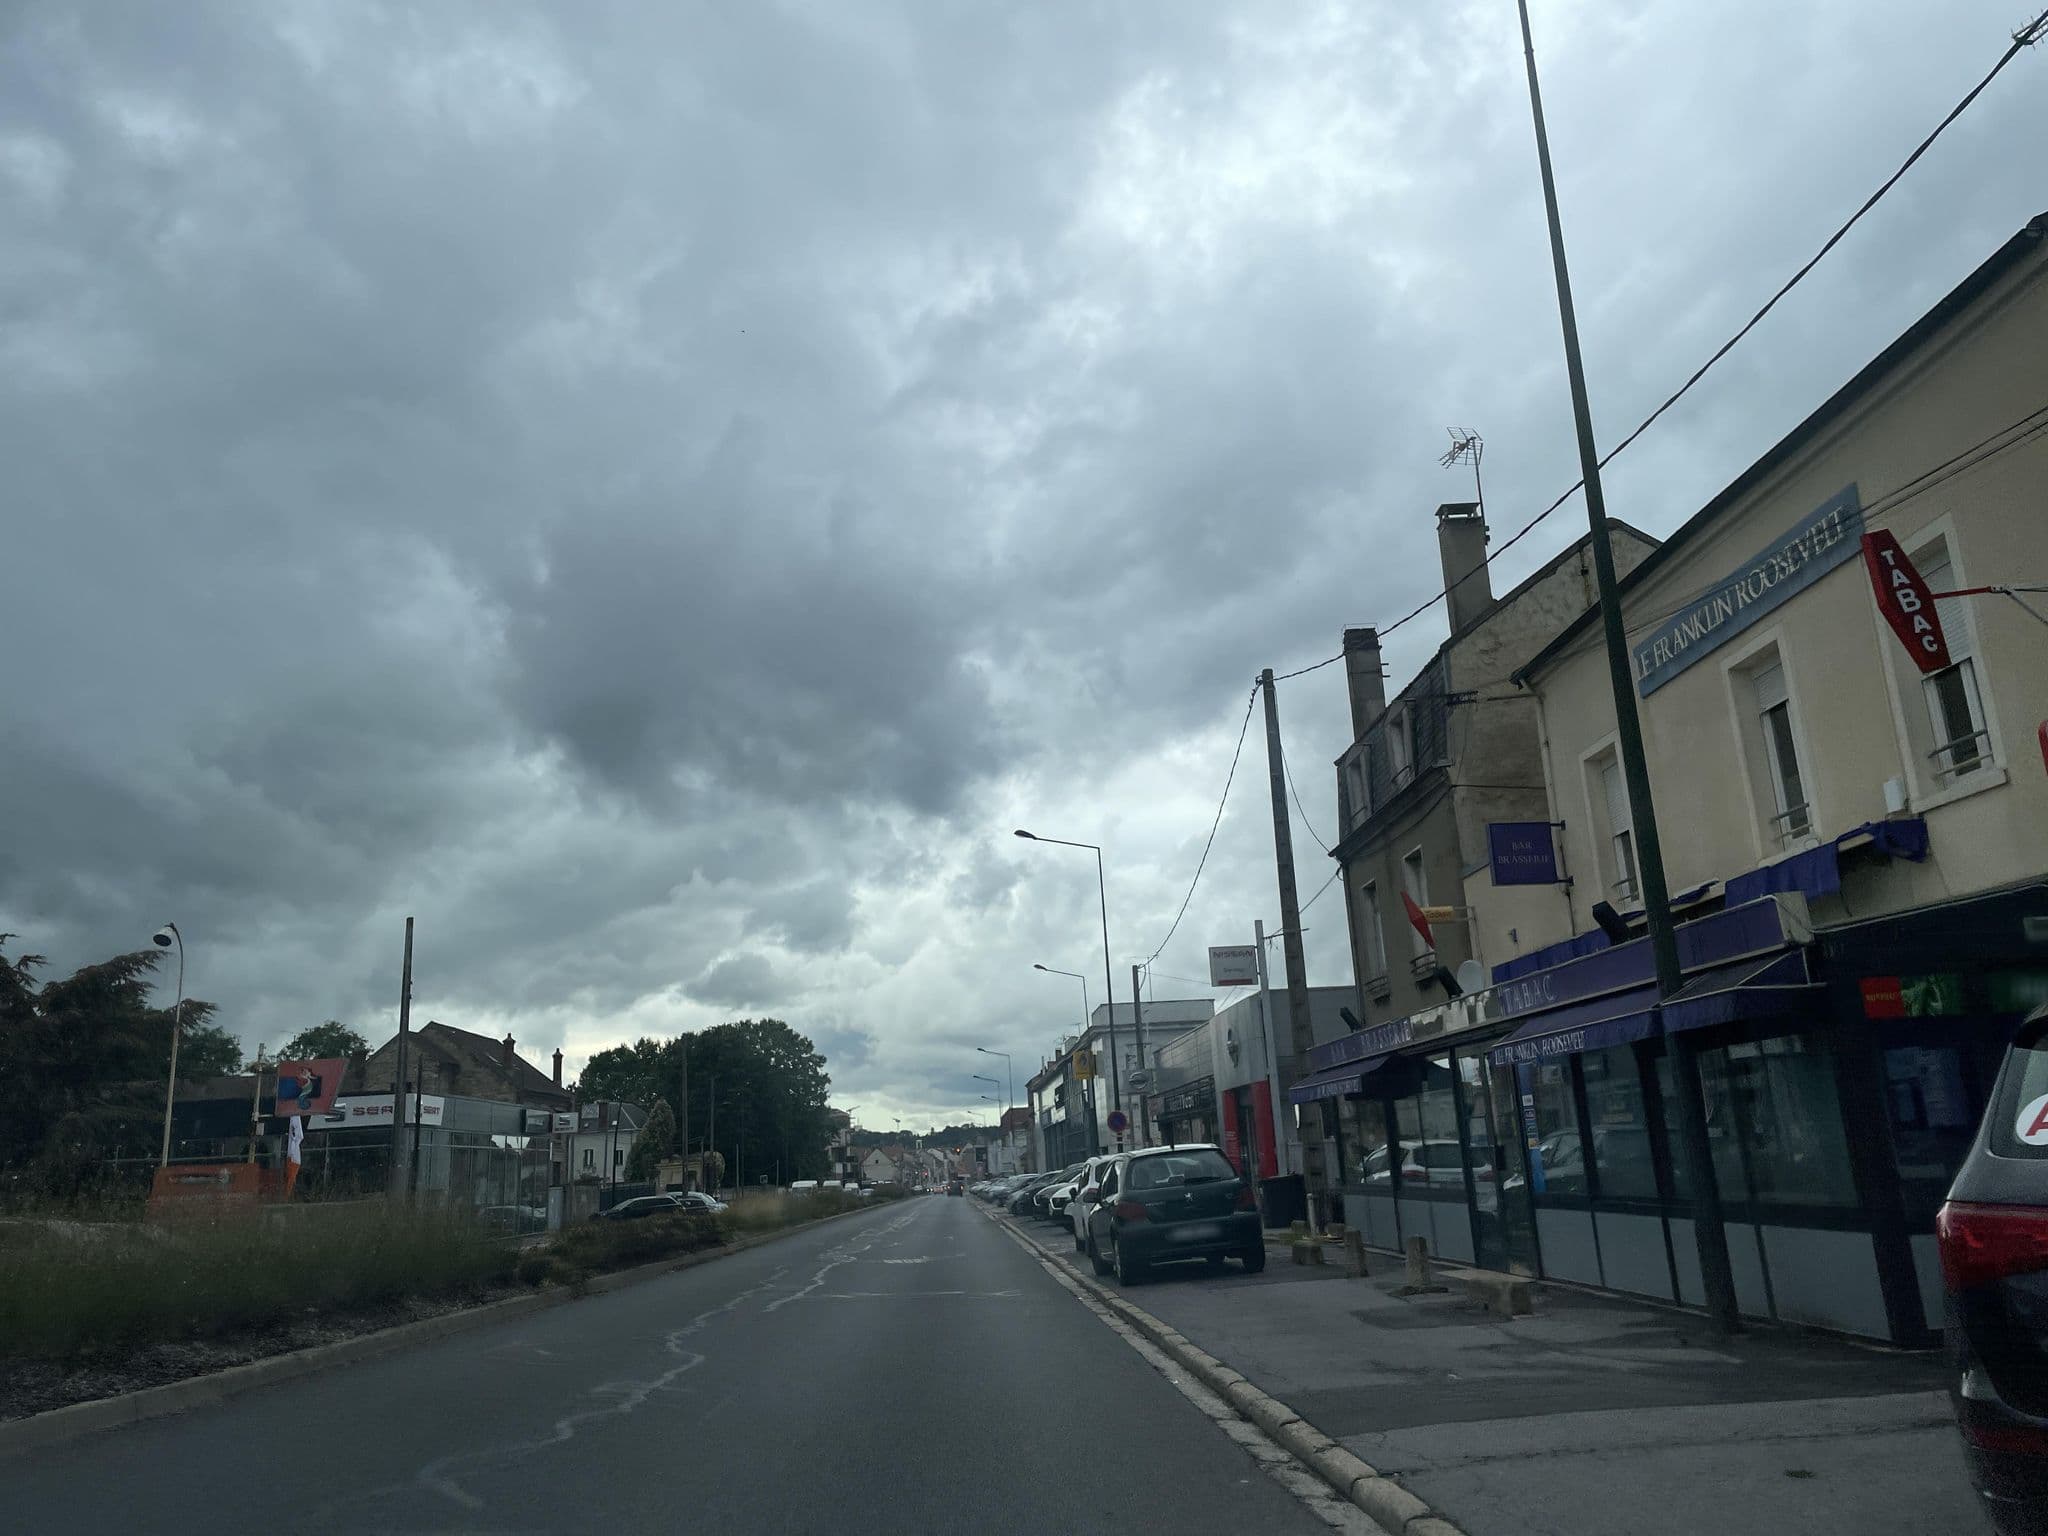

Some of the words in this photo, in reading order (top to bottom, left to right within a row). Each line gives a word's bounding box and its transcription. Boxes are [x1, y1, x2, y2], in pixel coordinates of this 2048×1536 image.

[1652, 588, 1734, 669] FRANKLIN
[1735, 506, 1848, 611] ROOSEVELT
[1880, 549, 1940, 654] TABAC
[1497, 854, 1552, 866] BRASSERIE
[1213, 950, 1253, 959] NISSAN
[1505, 975, 1558, 1014] TABAC
[353, 1105, 393, 1116] SEA
